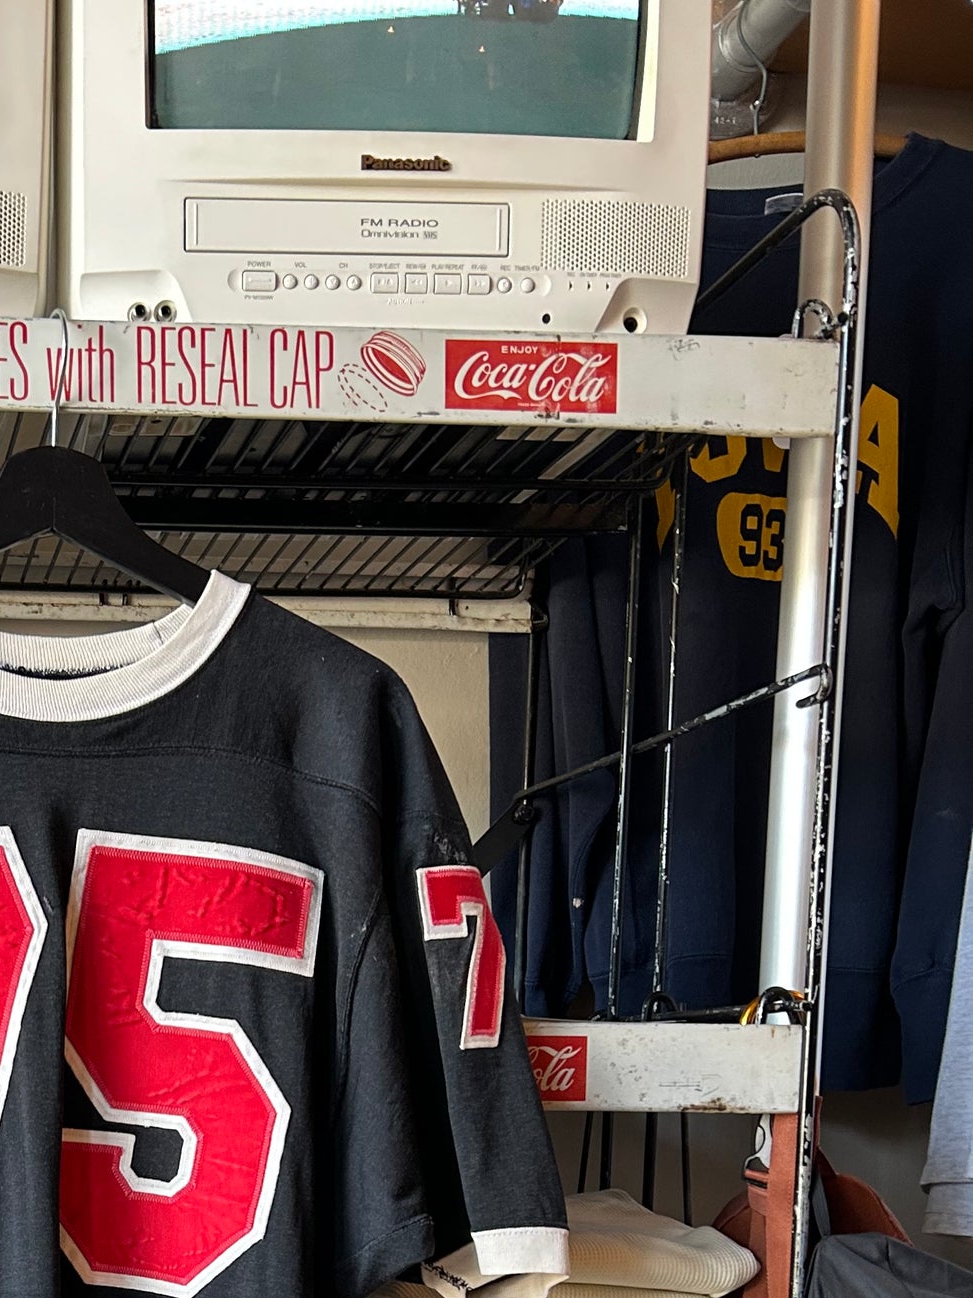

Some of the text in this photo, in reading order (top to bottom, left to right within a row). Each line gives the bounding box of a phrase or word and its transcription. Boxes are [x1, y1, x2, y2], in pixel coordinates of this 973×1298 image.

[361, 154, 452, 172] Panasonic
[360, 218, 439, 228] FM RADIO
[361, 229, 419, 239] Omnivision
[294, 261, 307, 269] VOL
[501, 345, 539, 355] ENJOY
[46, 323, 115, 403] with
[136, 325, 258, 407] RESEAL
[269, 327, 334, 409] CAP
[454, 351, 612, 403] Coca-Cola
[739, 503, 785, 573] 93
[417, 864, 507, 1048] 7
